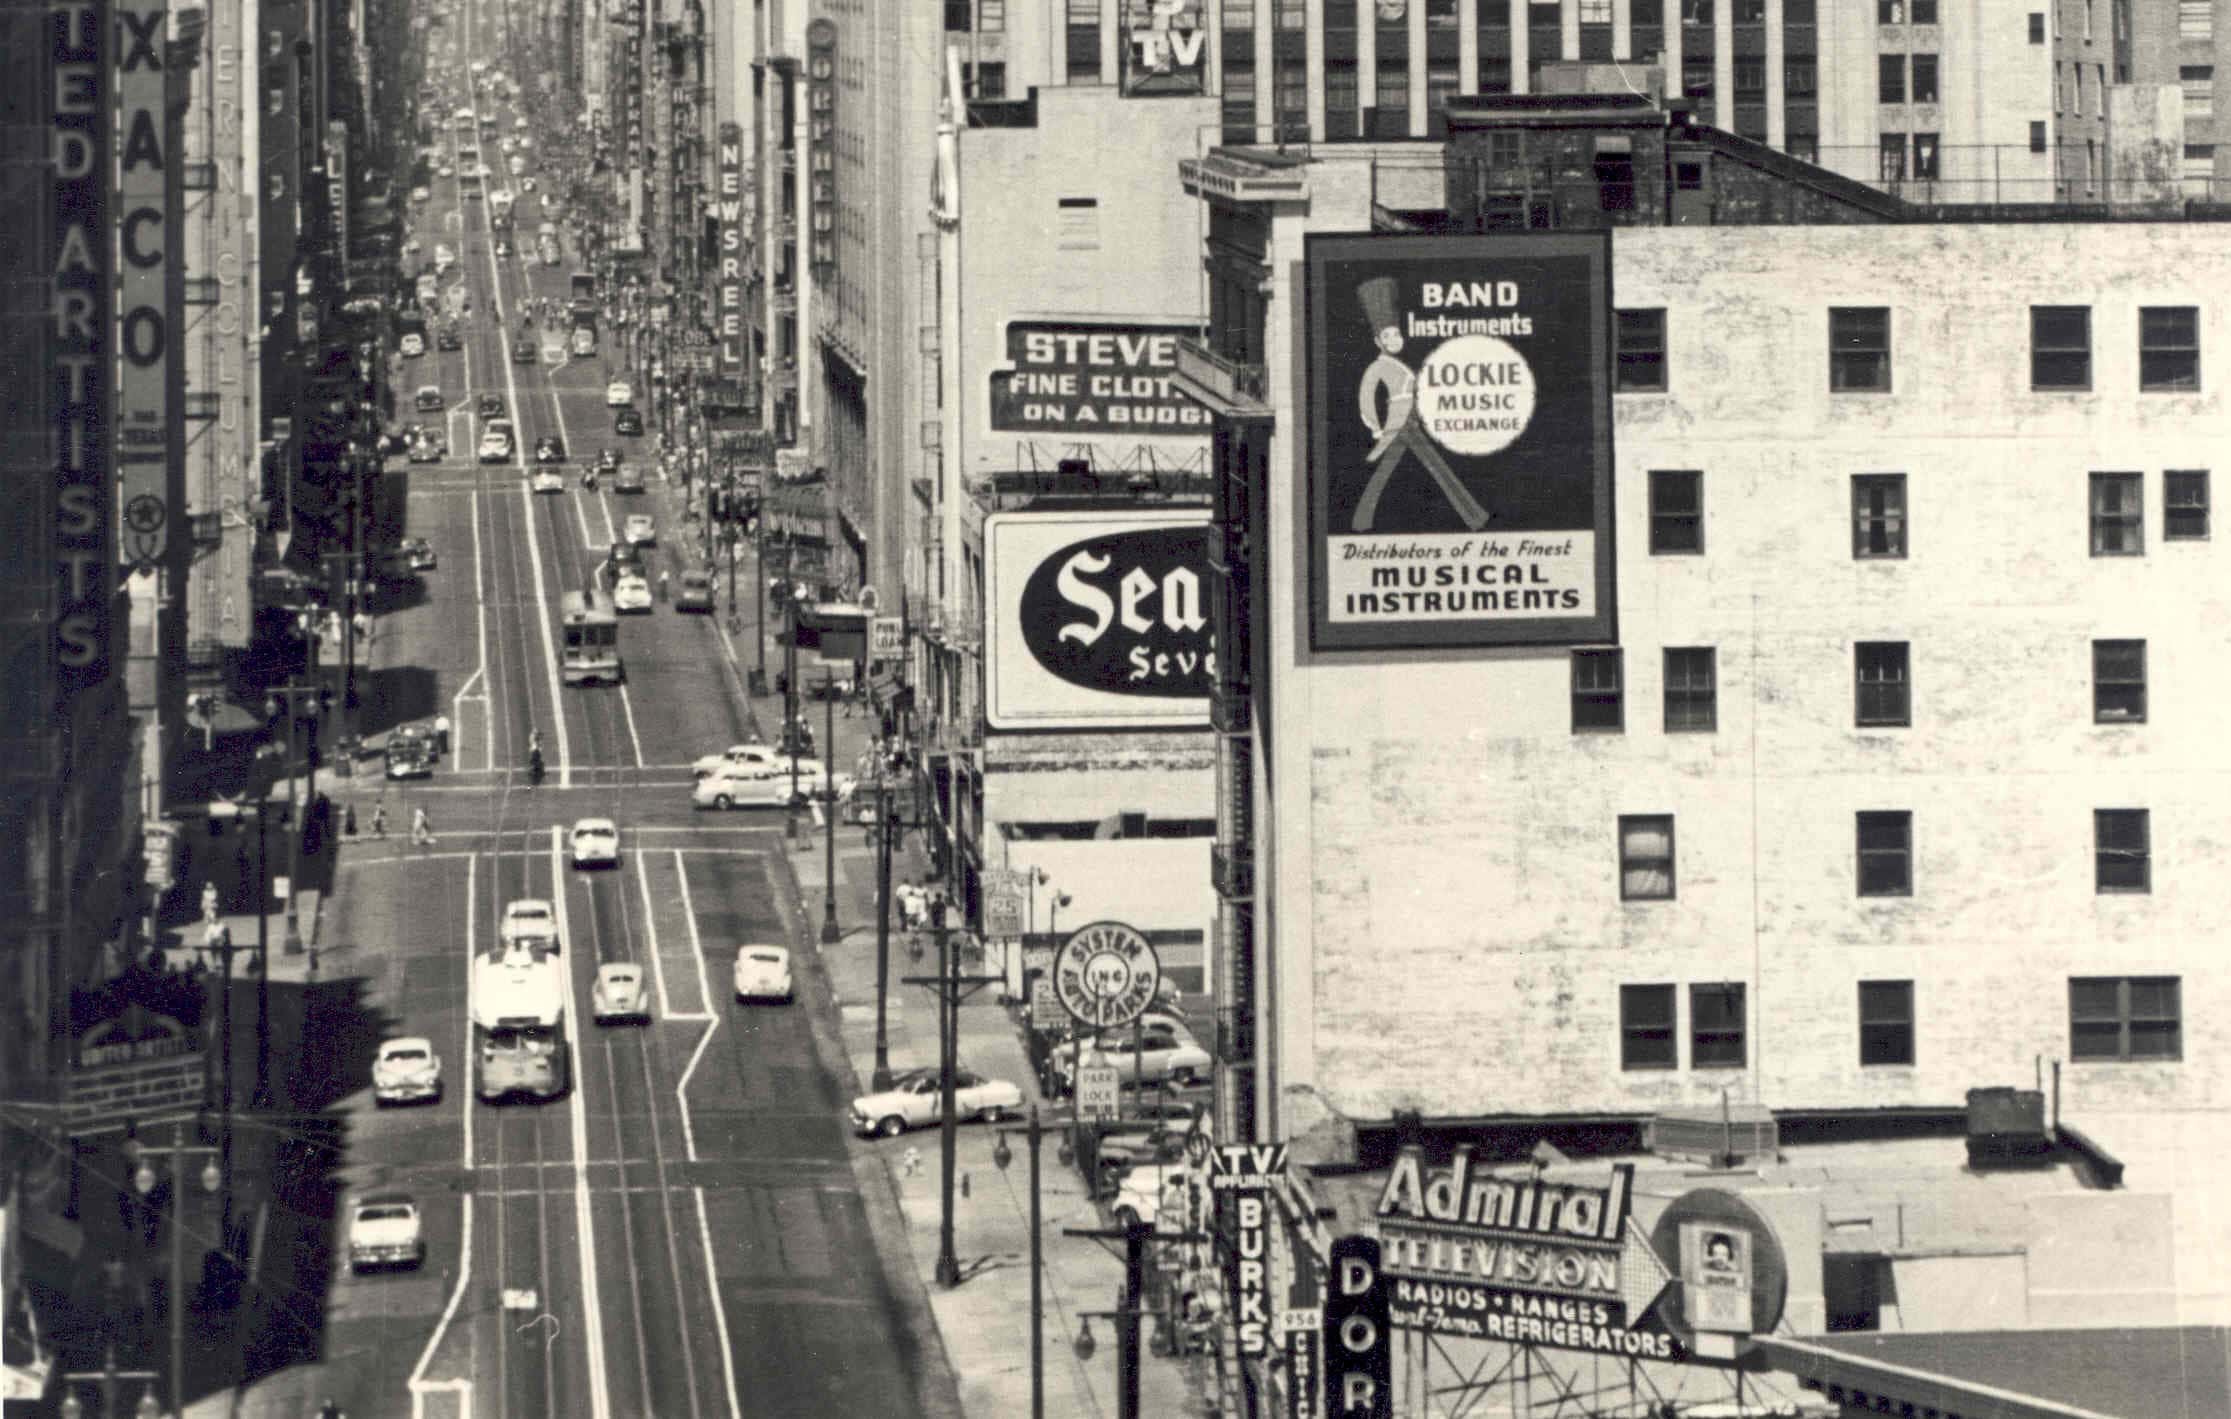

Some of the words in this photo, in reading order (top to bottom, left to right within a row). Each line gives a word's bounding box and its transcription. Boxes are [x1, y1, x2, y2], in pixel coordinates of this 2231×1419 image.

[1131, 29, 1204, 67] TV
[721, 144, 740, 363] NEWSREEL
[1422, 282, 1519, 308] BAND
[1408, 311, 1533, 337] Instruments
[1025, 333, 1176, 367] STEVE
[1010, 373, 1078, 396] FINE
[1090, 376, 1184, 399] CLOT
[1428, 362, 1521, 387] LOCKIE
[1024, 404, 1066, 421] ON
[1075, 405, 1099, 423] A
[1437, 394, 1516, 411] MUSIC
[216, 252, 243, 624] COLUMBIA
[1434, 418, 1521, 432] EXCHANGE
[57, 223, 99, 667] ARTISTS
[1343, 543, 1441, 560] Distributors
[1451, 541, 1472, 558] of
[1480, 539, 1508, 557] the
[1517, 539, 1572, 556] Finest
[1057, 550, 1207, 647] Sea
[1072, 930, 1142, 962] SYSTEM
[1103, 971, 1152, 1019] PARKS
[1222, 1146, 1275, 1174] TV
[1377, 1147, 1627, 1241] Admiral
[1239, 1198, 1267, 1352] BURKS
[1384, 1232, 1618, 1292] TELEVISION
[1397, 1279, 1488, 1311] RADIOS
[1511, 1294, 1609, 1325] RANGES
[1340, 1257, 1378, 1411] DOR
[1486, 1314, 1672, 1358] REFRIGERATORS
